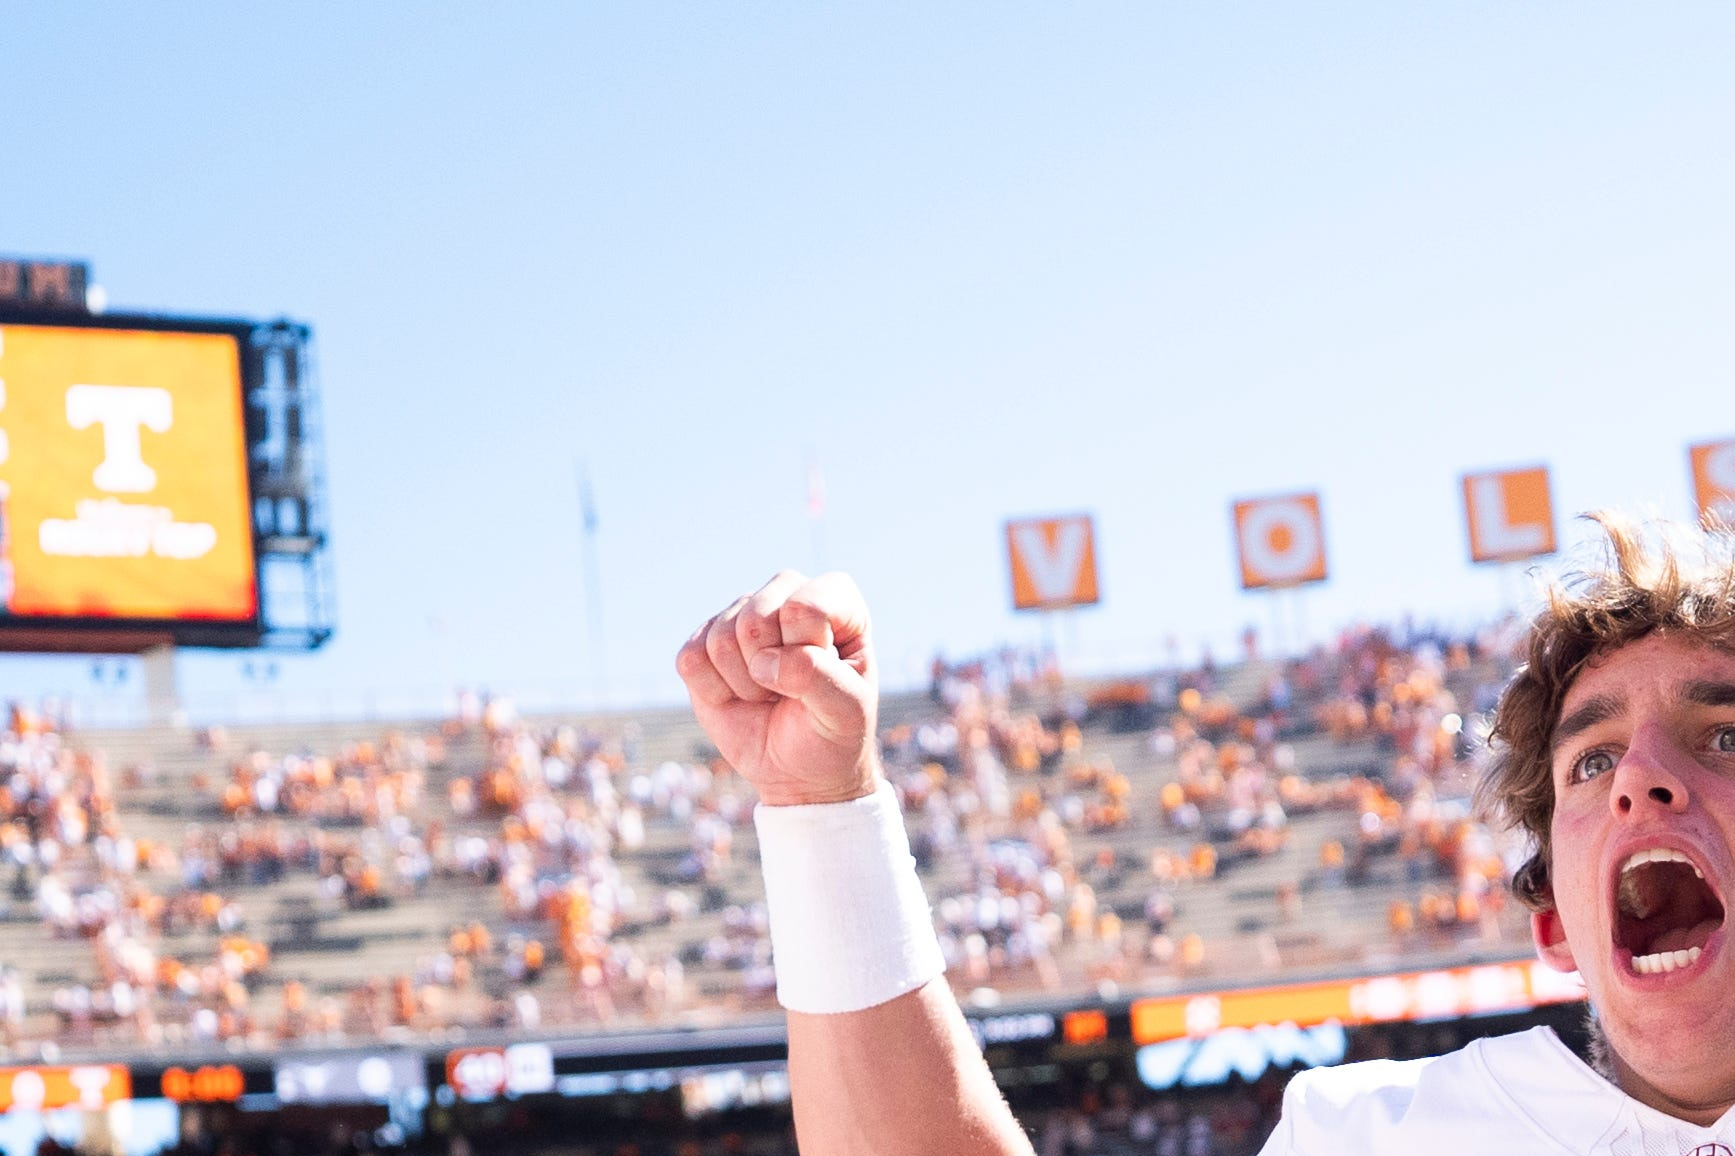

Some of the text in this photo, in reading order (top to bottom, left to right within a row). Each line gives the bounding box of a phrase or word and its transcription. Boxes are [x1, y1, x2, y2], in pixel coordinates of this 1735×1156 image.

[65, 383, 173, 492] T
[1012, 519, 1088, 601] V
[1240, 498, 1320, 580] O
[1470, 473, 1549, 552] L
